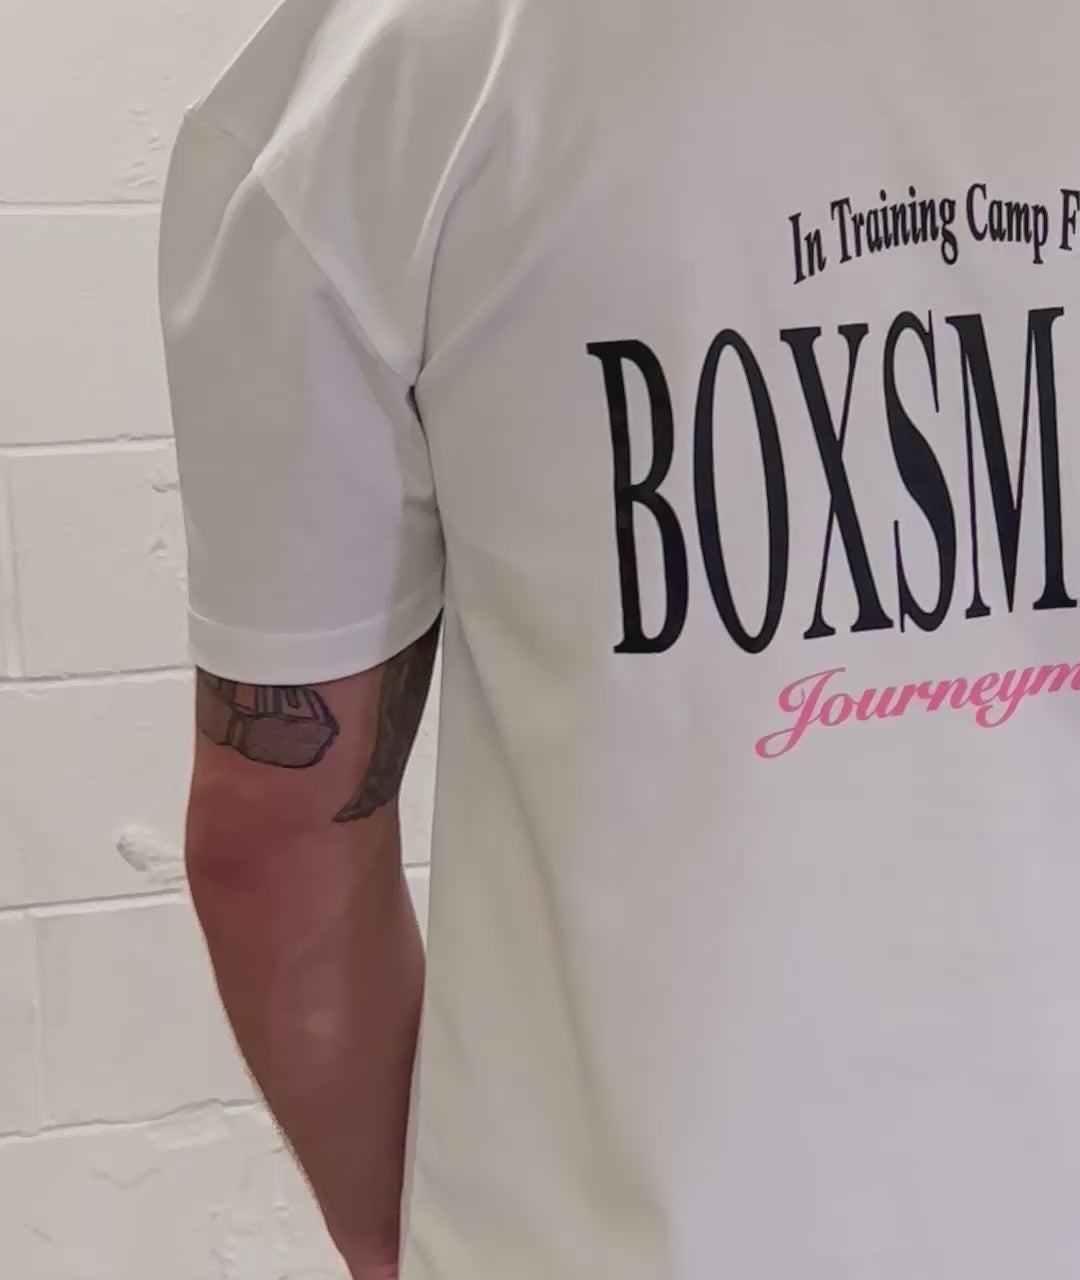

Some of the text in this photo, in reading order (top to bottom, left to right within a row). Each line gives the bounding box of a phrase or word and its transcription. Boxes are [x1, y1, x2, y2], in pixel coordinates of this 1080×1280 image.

[789, 213, 827, 285] In
[831, 186, 959, 266] Training
[966, 183, 1049, 265] Camp
